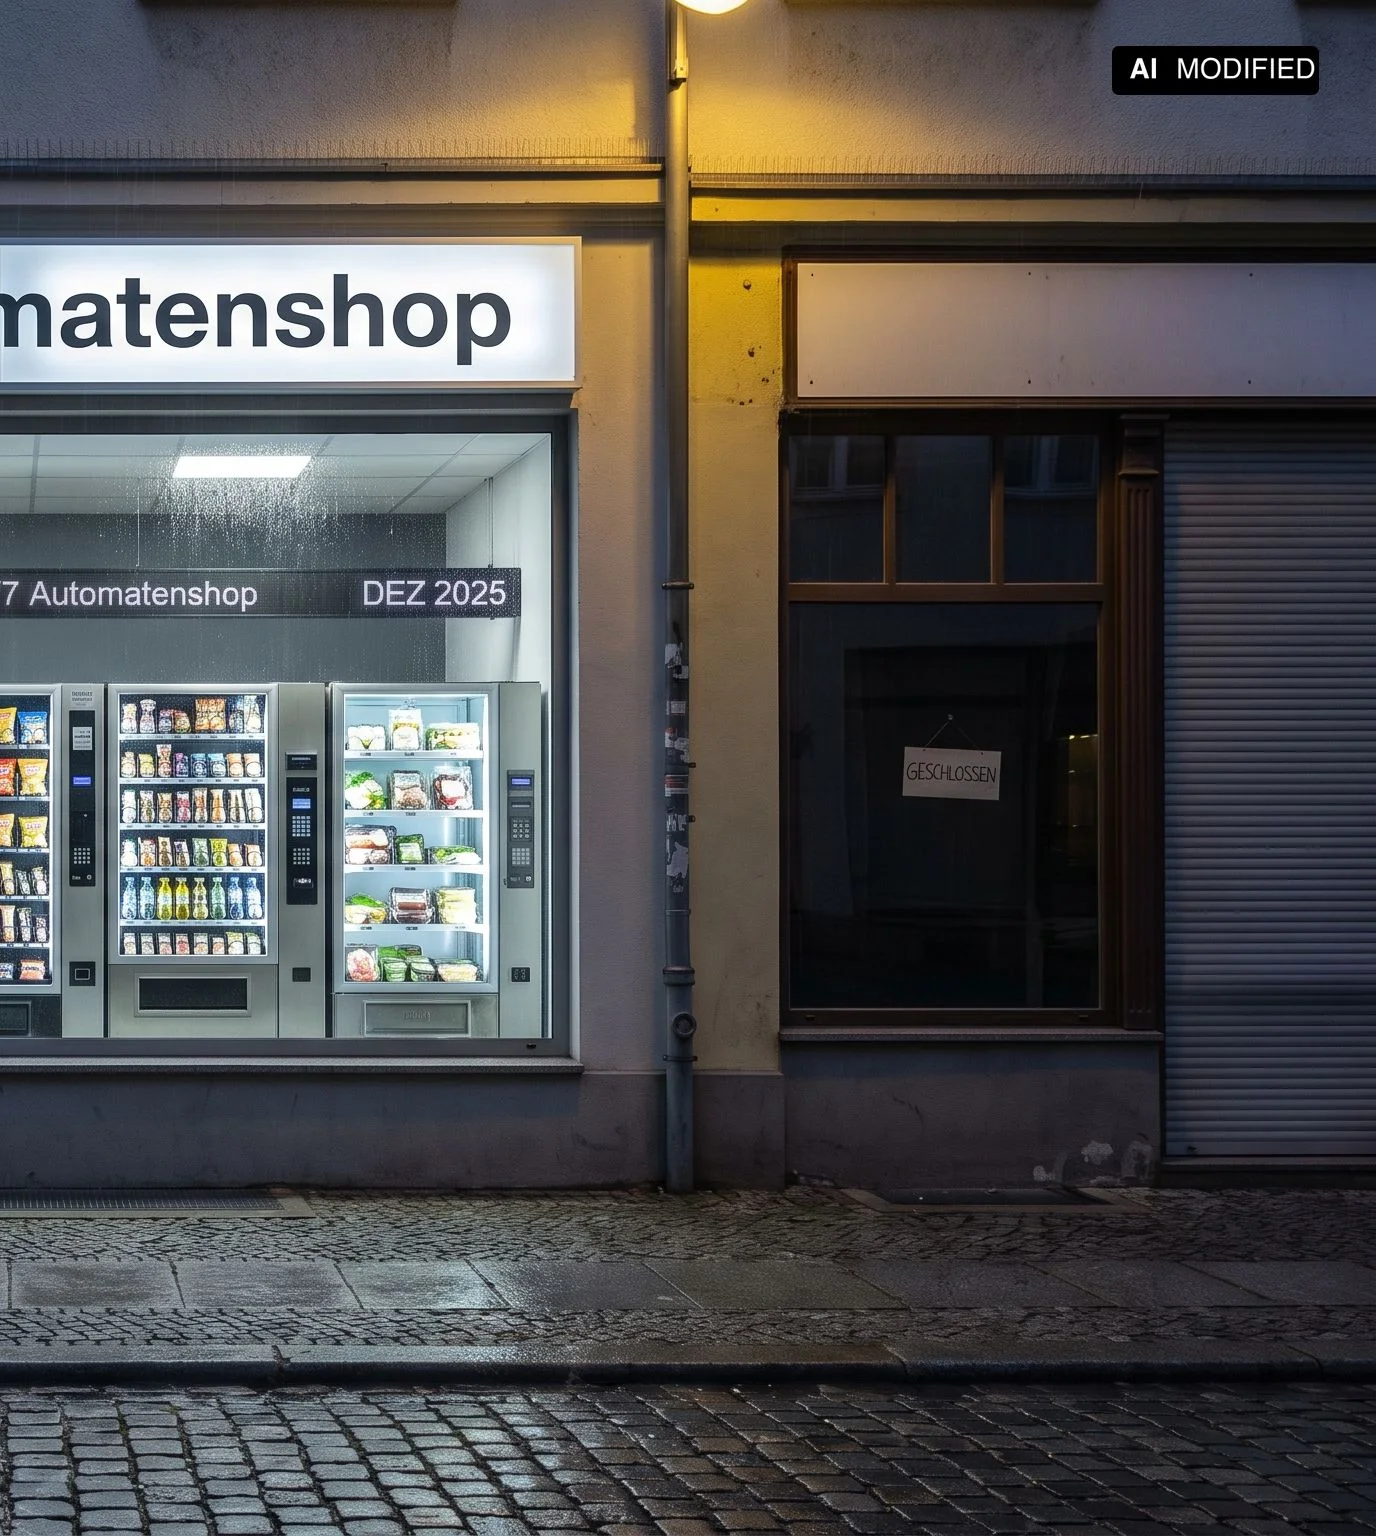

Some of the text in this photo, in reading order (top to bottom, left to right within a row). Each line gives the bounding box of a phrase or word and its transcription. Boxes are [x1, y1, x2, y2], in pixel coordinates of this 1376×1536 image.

[29, 580, 258, 612] Automatenshop
[363, 580, 507, 606] DEZ 2025
[906, 762, 997, 783] GESCHLOSSEN
